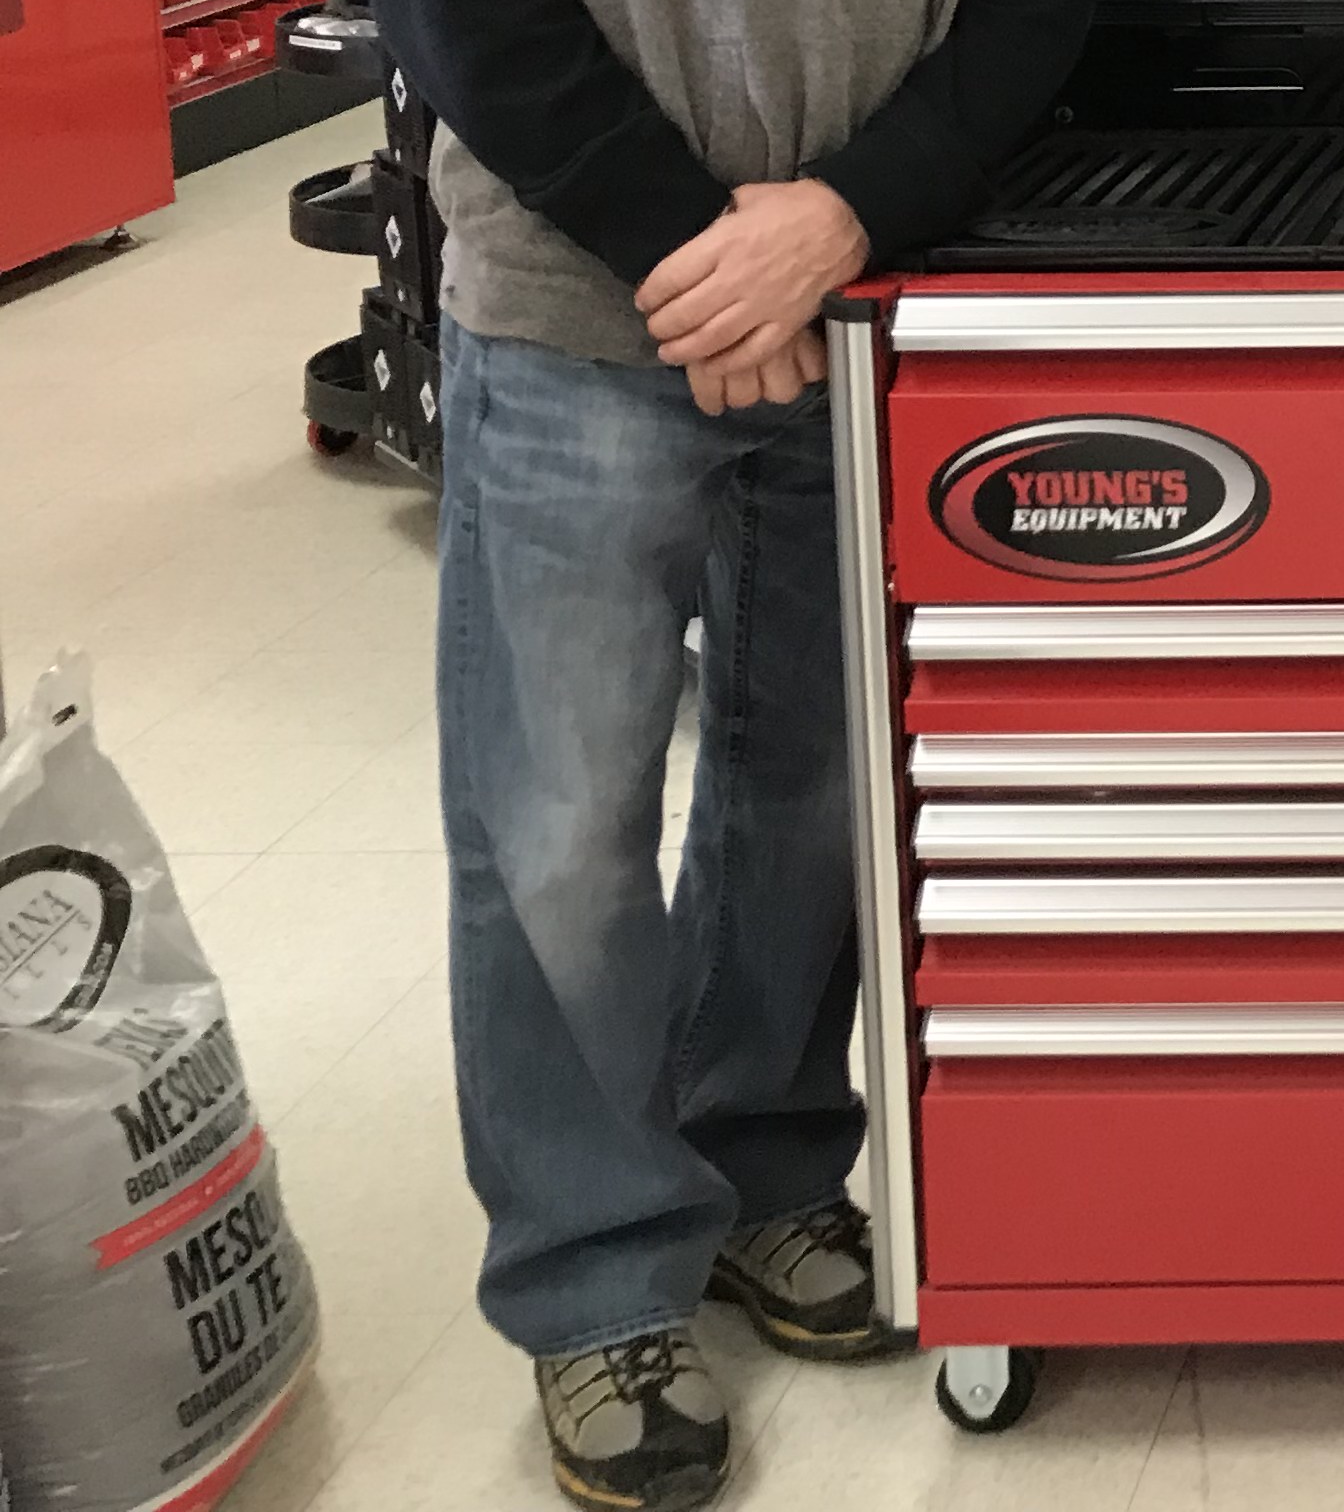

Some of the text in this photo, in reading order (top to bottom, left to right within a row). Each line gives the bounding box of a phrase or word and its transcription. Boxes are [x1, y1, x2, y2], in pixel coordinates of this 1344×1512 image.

[1007, 469, 1189, 506] YOUNG'S
[1009, 505, 1188, 533] EQUIPMENT
[187, 1289, 246, 1375] DU
